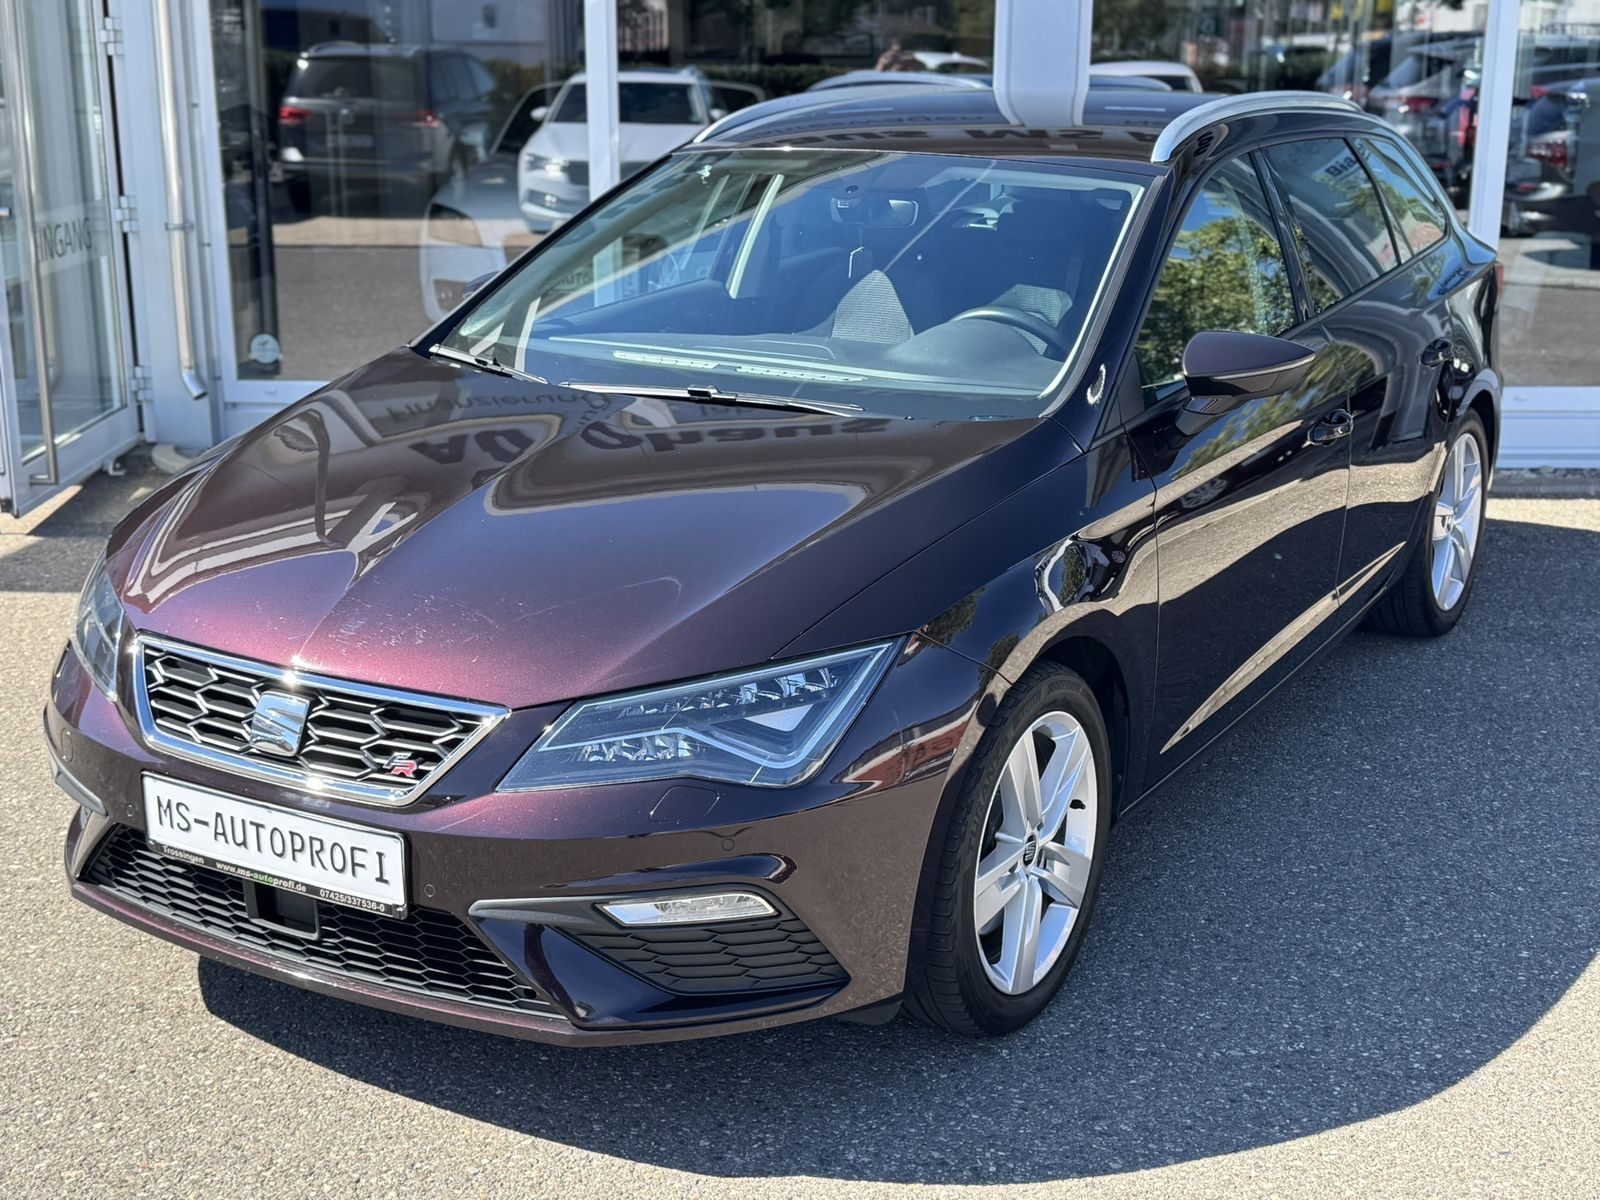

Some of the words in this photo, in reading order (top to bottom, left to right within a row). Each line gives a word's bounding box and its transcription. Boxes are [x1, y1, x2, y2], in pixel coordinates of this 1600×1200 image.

[37, 217, 92, 262] INGANG
[157, 795, 391, 886] MS-AUTOPROFI
[162, 845, 204, 865] Trossingen
[216, 861, 307, 893] www.ms-autoprofi.de
